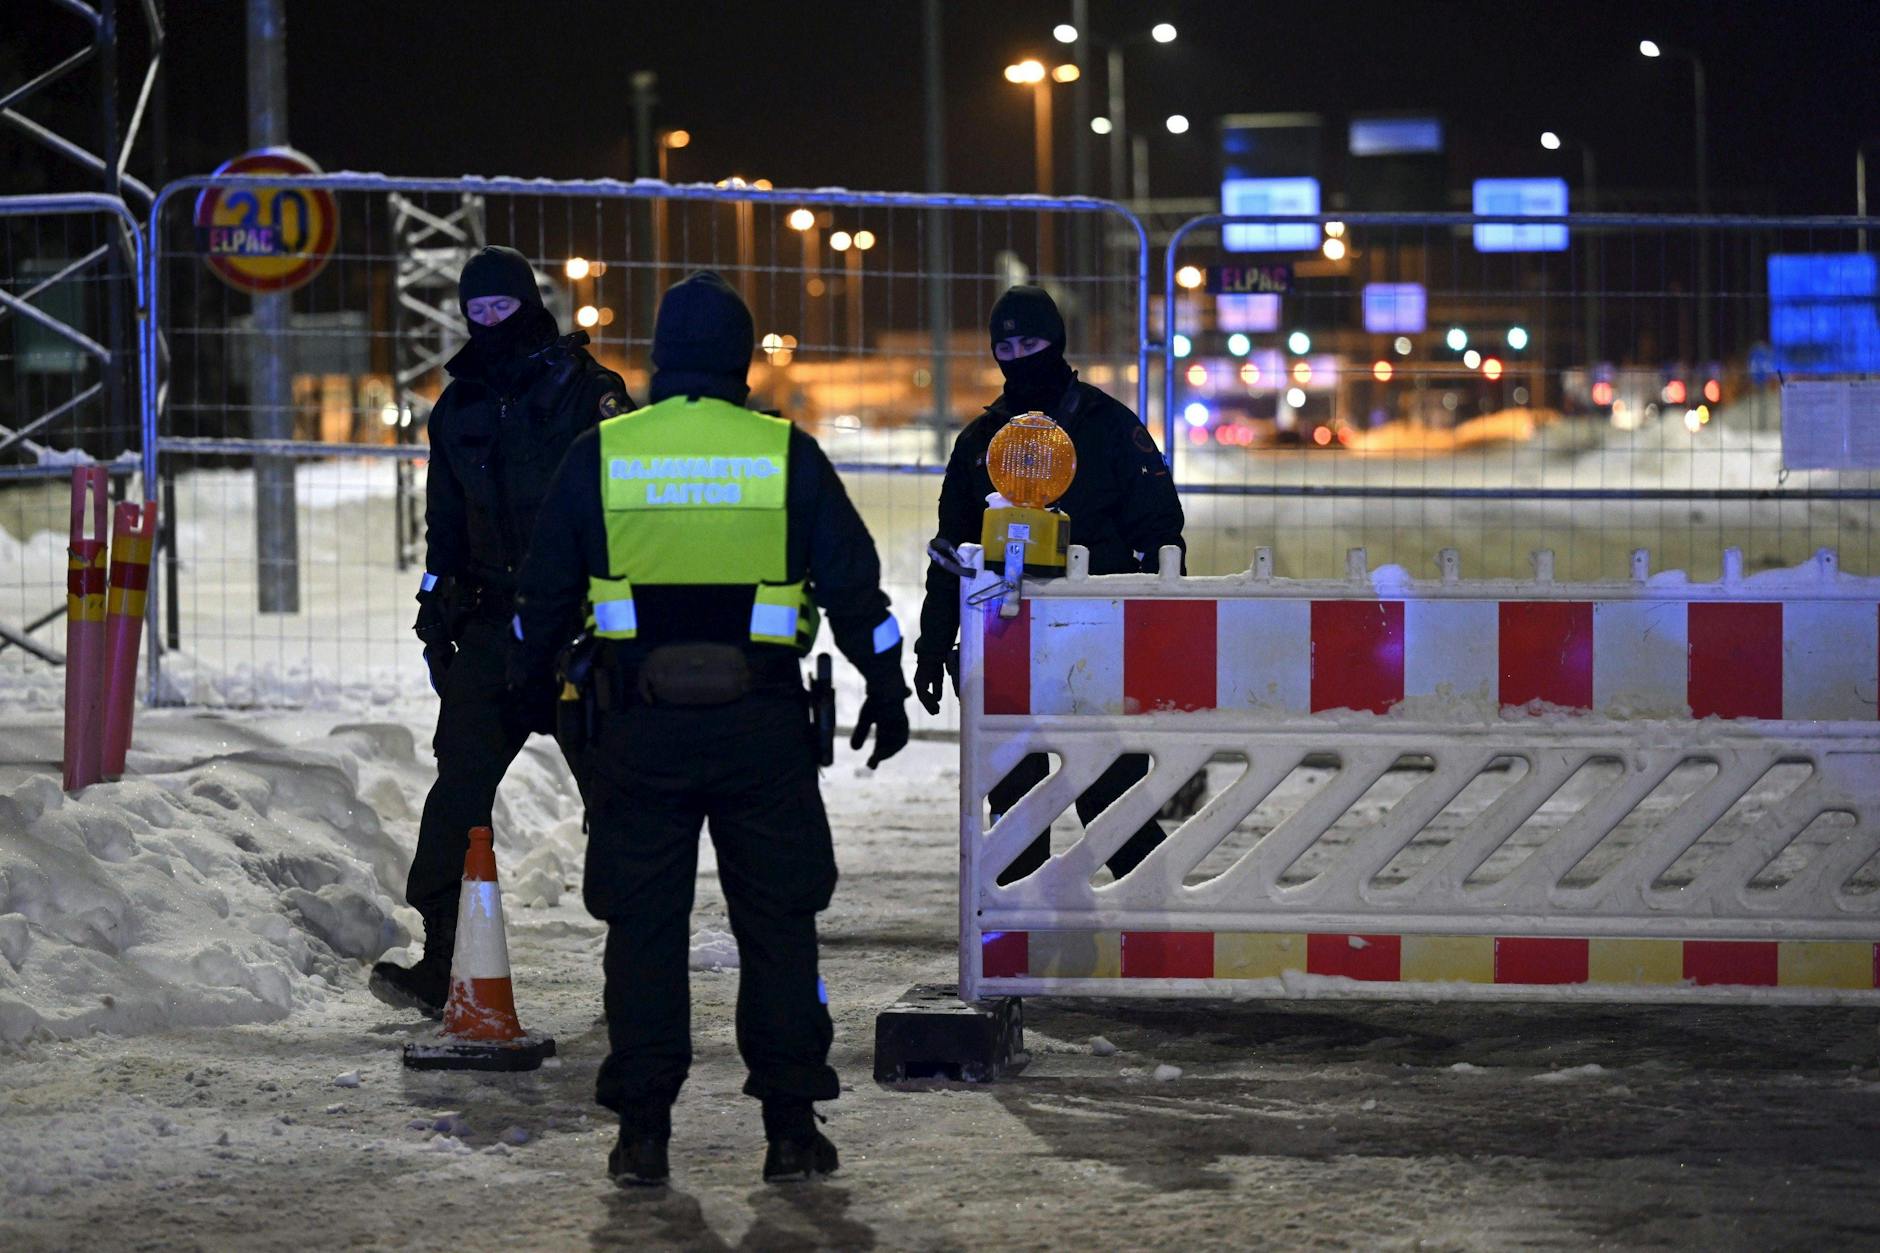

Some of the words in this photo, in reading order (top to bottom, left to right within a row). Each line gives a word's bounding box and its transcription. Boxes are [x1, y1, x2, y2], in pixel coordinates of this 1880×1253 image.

[226, 190, 309, 252] 20
[210, 228, 273, 253] ELPAC
[1221, 267, 1287, 291] ELPAC
[645, 483, 741, 504] LAITOS
